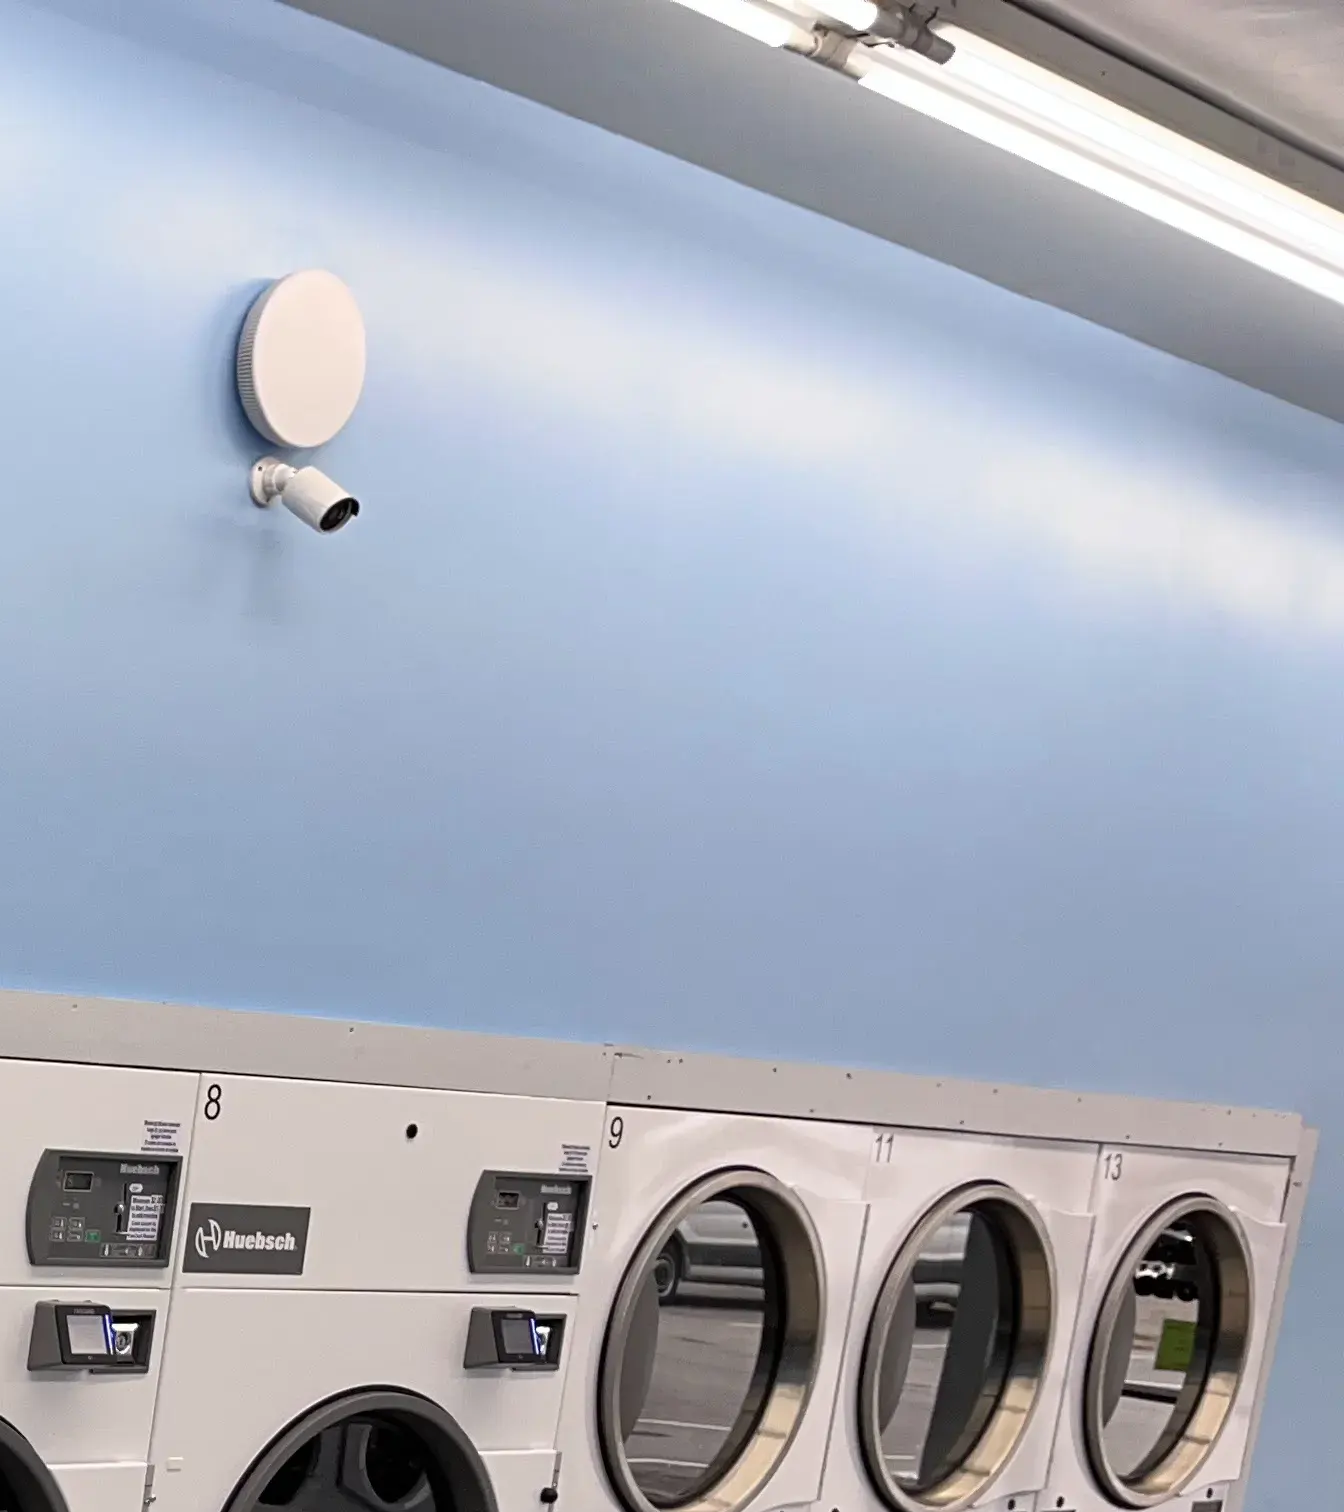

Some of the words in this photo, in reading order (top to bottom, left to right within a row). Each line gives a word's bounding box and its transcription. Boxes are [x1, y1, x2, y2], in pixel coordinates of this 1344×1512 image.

[204, 1083, 222, 1121] 8
[608, 1116, 624, 1149] 9
[875, 1132, 895, 1163] 11
[1104, 1153, 1123, 1181] 13
[222, 1230, 296, 1251] Huebsch
